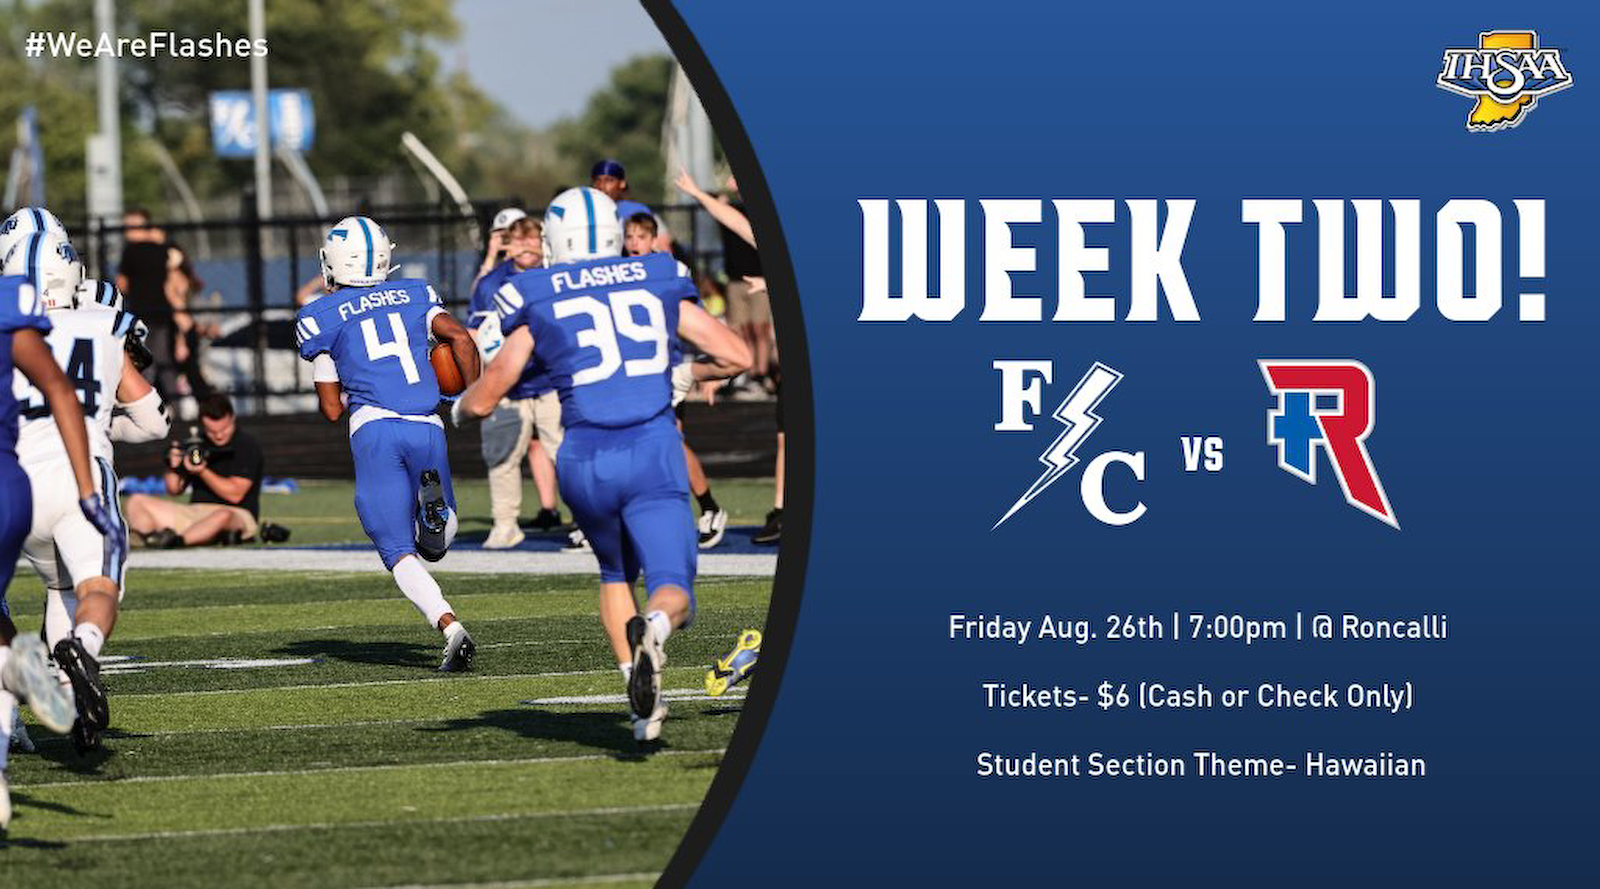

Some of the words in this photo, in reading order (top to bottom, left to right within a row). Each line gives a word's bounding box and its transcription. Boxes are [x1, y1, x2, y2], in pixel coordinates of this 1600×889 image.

[551, 262, 648, 294] FLASHES
[338, 289, 411, 322] FLASHES
[360, 312, 421, 385] 4
[553, 288, 670, 387] 39
